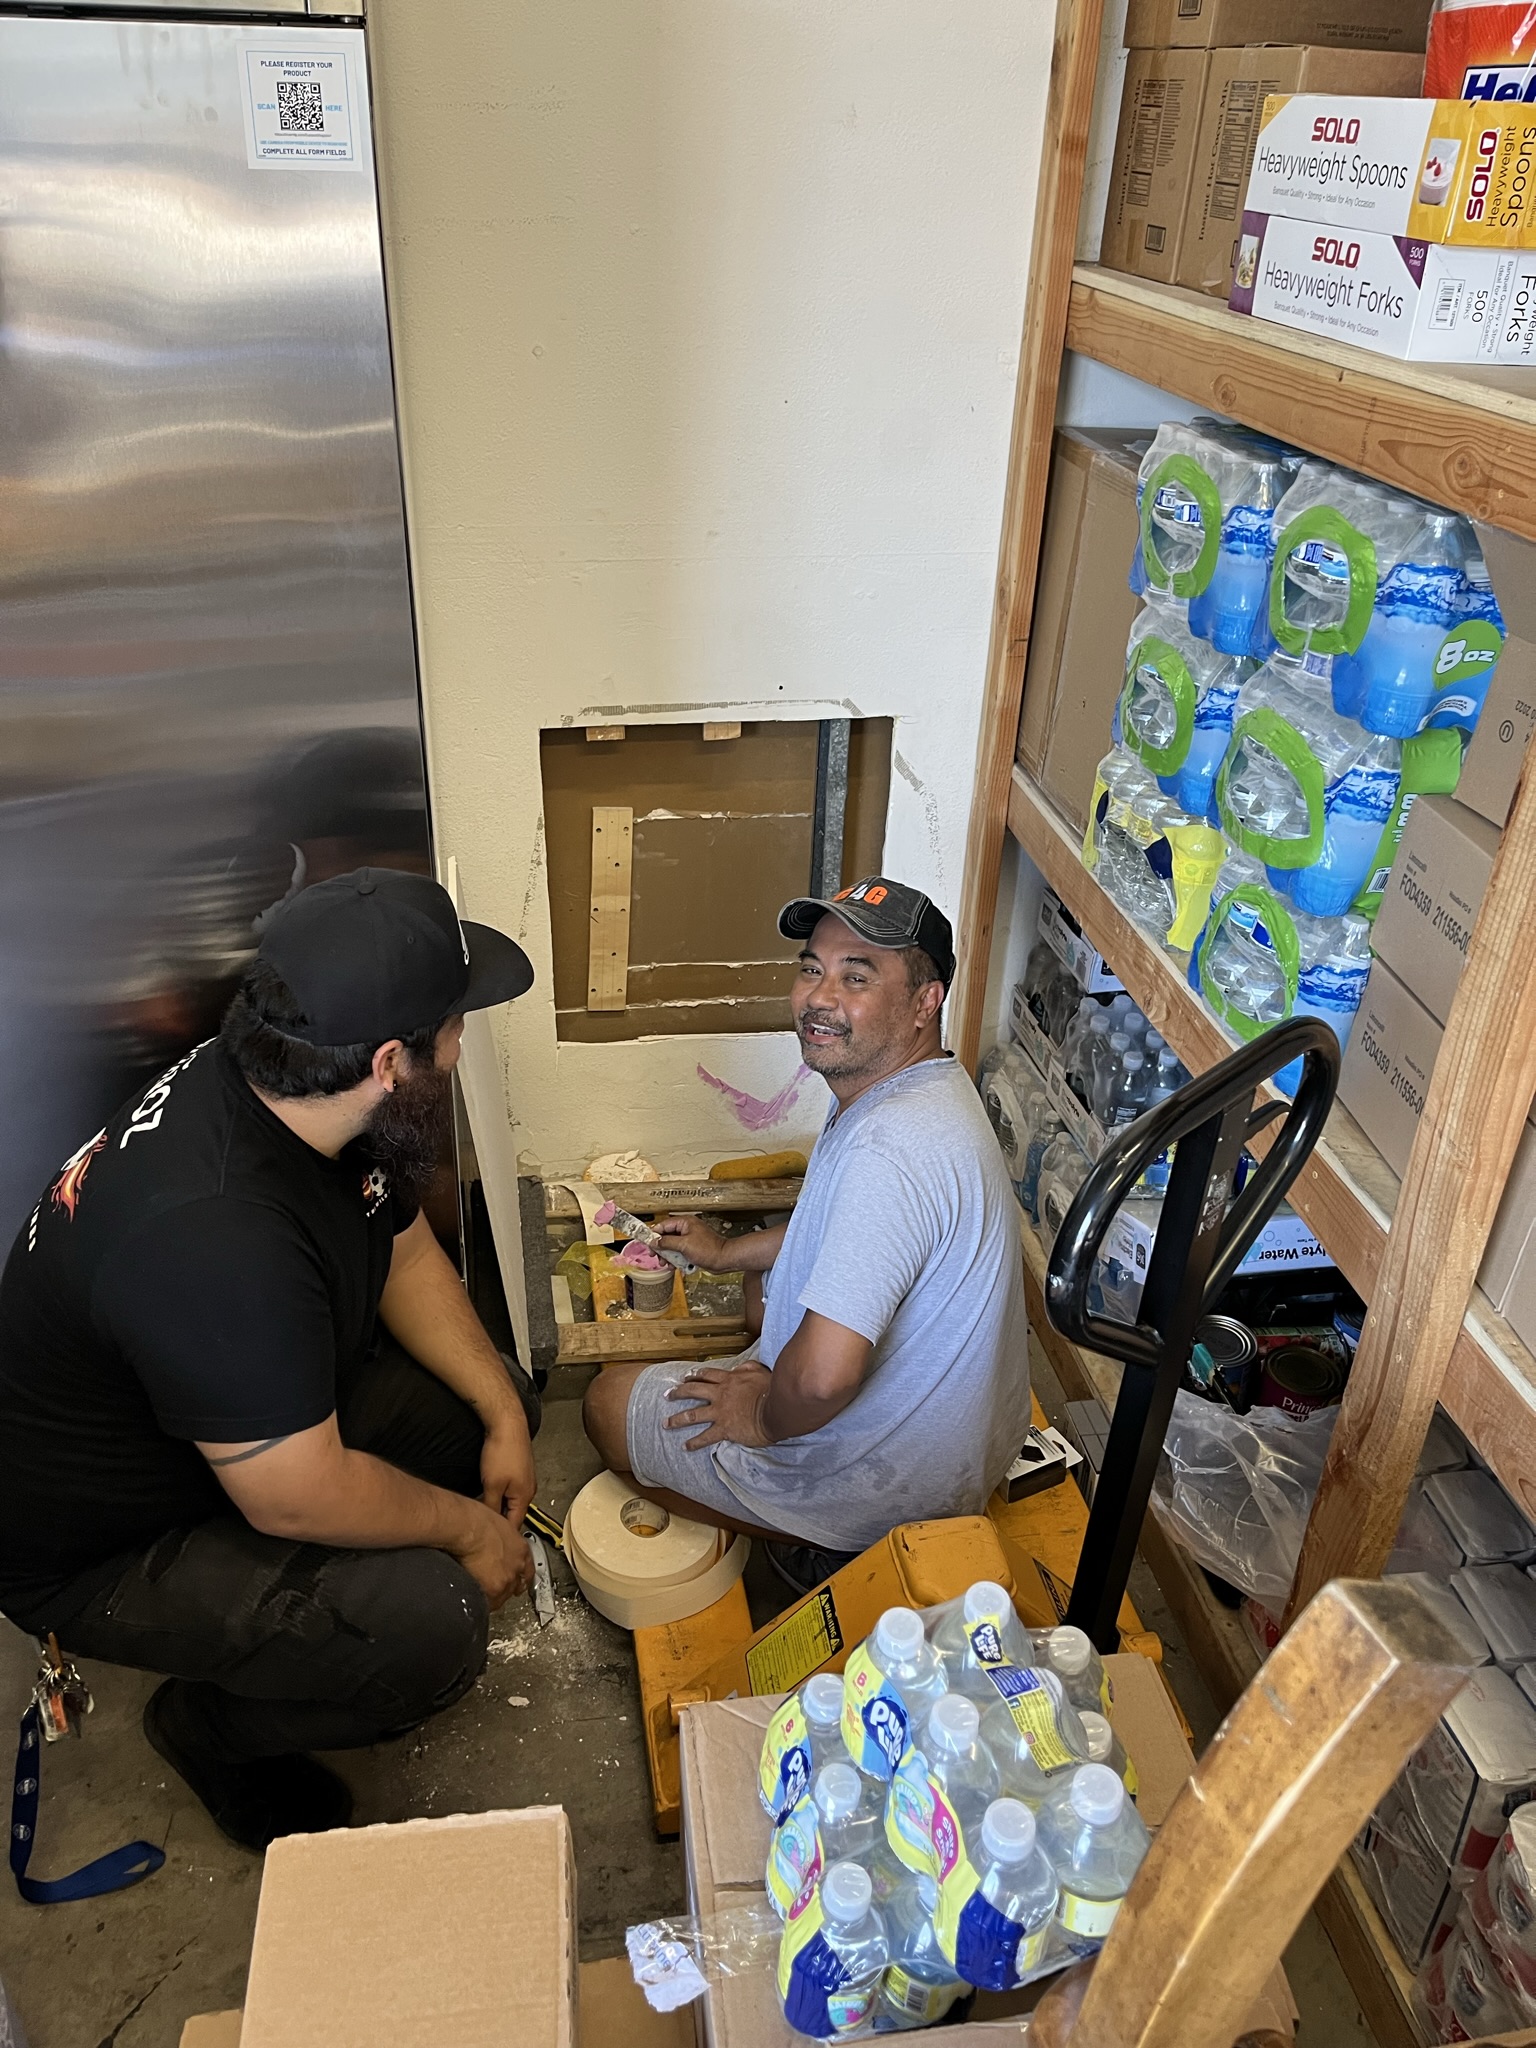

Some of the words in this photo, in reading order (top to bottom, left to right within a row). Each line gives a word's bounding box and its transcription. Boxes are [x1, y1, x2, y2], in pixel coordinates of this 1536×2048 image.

[1312, 117, 1360, 144] SOLO
[1258, 146, 1347, 184] Heavyweight
[1349, 154, 1408, 189] Spoons
[1466, 130, 1498, 220] SOLO
[1486, 126, 1517, 227] Heavyweight
[1500, 127, 1536, 228] Spoons
[1290, 188, 1304, 199] Quality
[1307, 191, 1322, 202] Strong
[1326, 193, 1338, 202] Ideal
[1345, 196, 1354, 207] Any
[1354, 198, 1376, 209] Occasion
[1312, 236, 1360, 268] SOLO
[1410, 246, 1425, 259] 500
[1264, 260, 1353, 308] Heavyweight
[1357, 282, 1404, 318] Forks
[1493, 285, 1501, 296] for
[1496, 265, 1505, 284] Ideal
[1502, 261, 1514, 293] Banquet
[1291, 305, 1306, 318] Quality
[1310, 310, 1324, 323] Strong
[1328, 315, 1339, 325] Ideal
[1347, 320, 1356, 332] Any
[1357, 323, 1379, 336] Occasion
[1463, 292, 1474, 320] FORKS
[1472, 290, 1488, 322] 500
[1495, 294, 1506, 321] Quality
[1506, 275, 1536, 342] Forks
[1482, 314, 1494, 349] Occasion
[1487, 329, 1498, 353] Strong
[1436, 640, 1467, 674] 8
[1400, 873, 1432, 916] FOD4359
[1361, 1030, 1390, 1074] FOD4359
[1390, 1067, 1425, 1117] 211556-0
[1258, 1248, 1299, 1260] Water
[1301, 1244, 1326, 1256] lyte
[823, 1602, 837, 1638] WARNING
[856, 1672, 867, 1687] 6
[785, 1718, 794, 1733] 6
